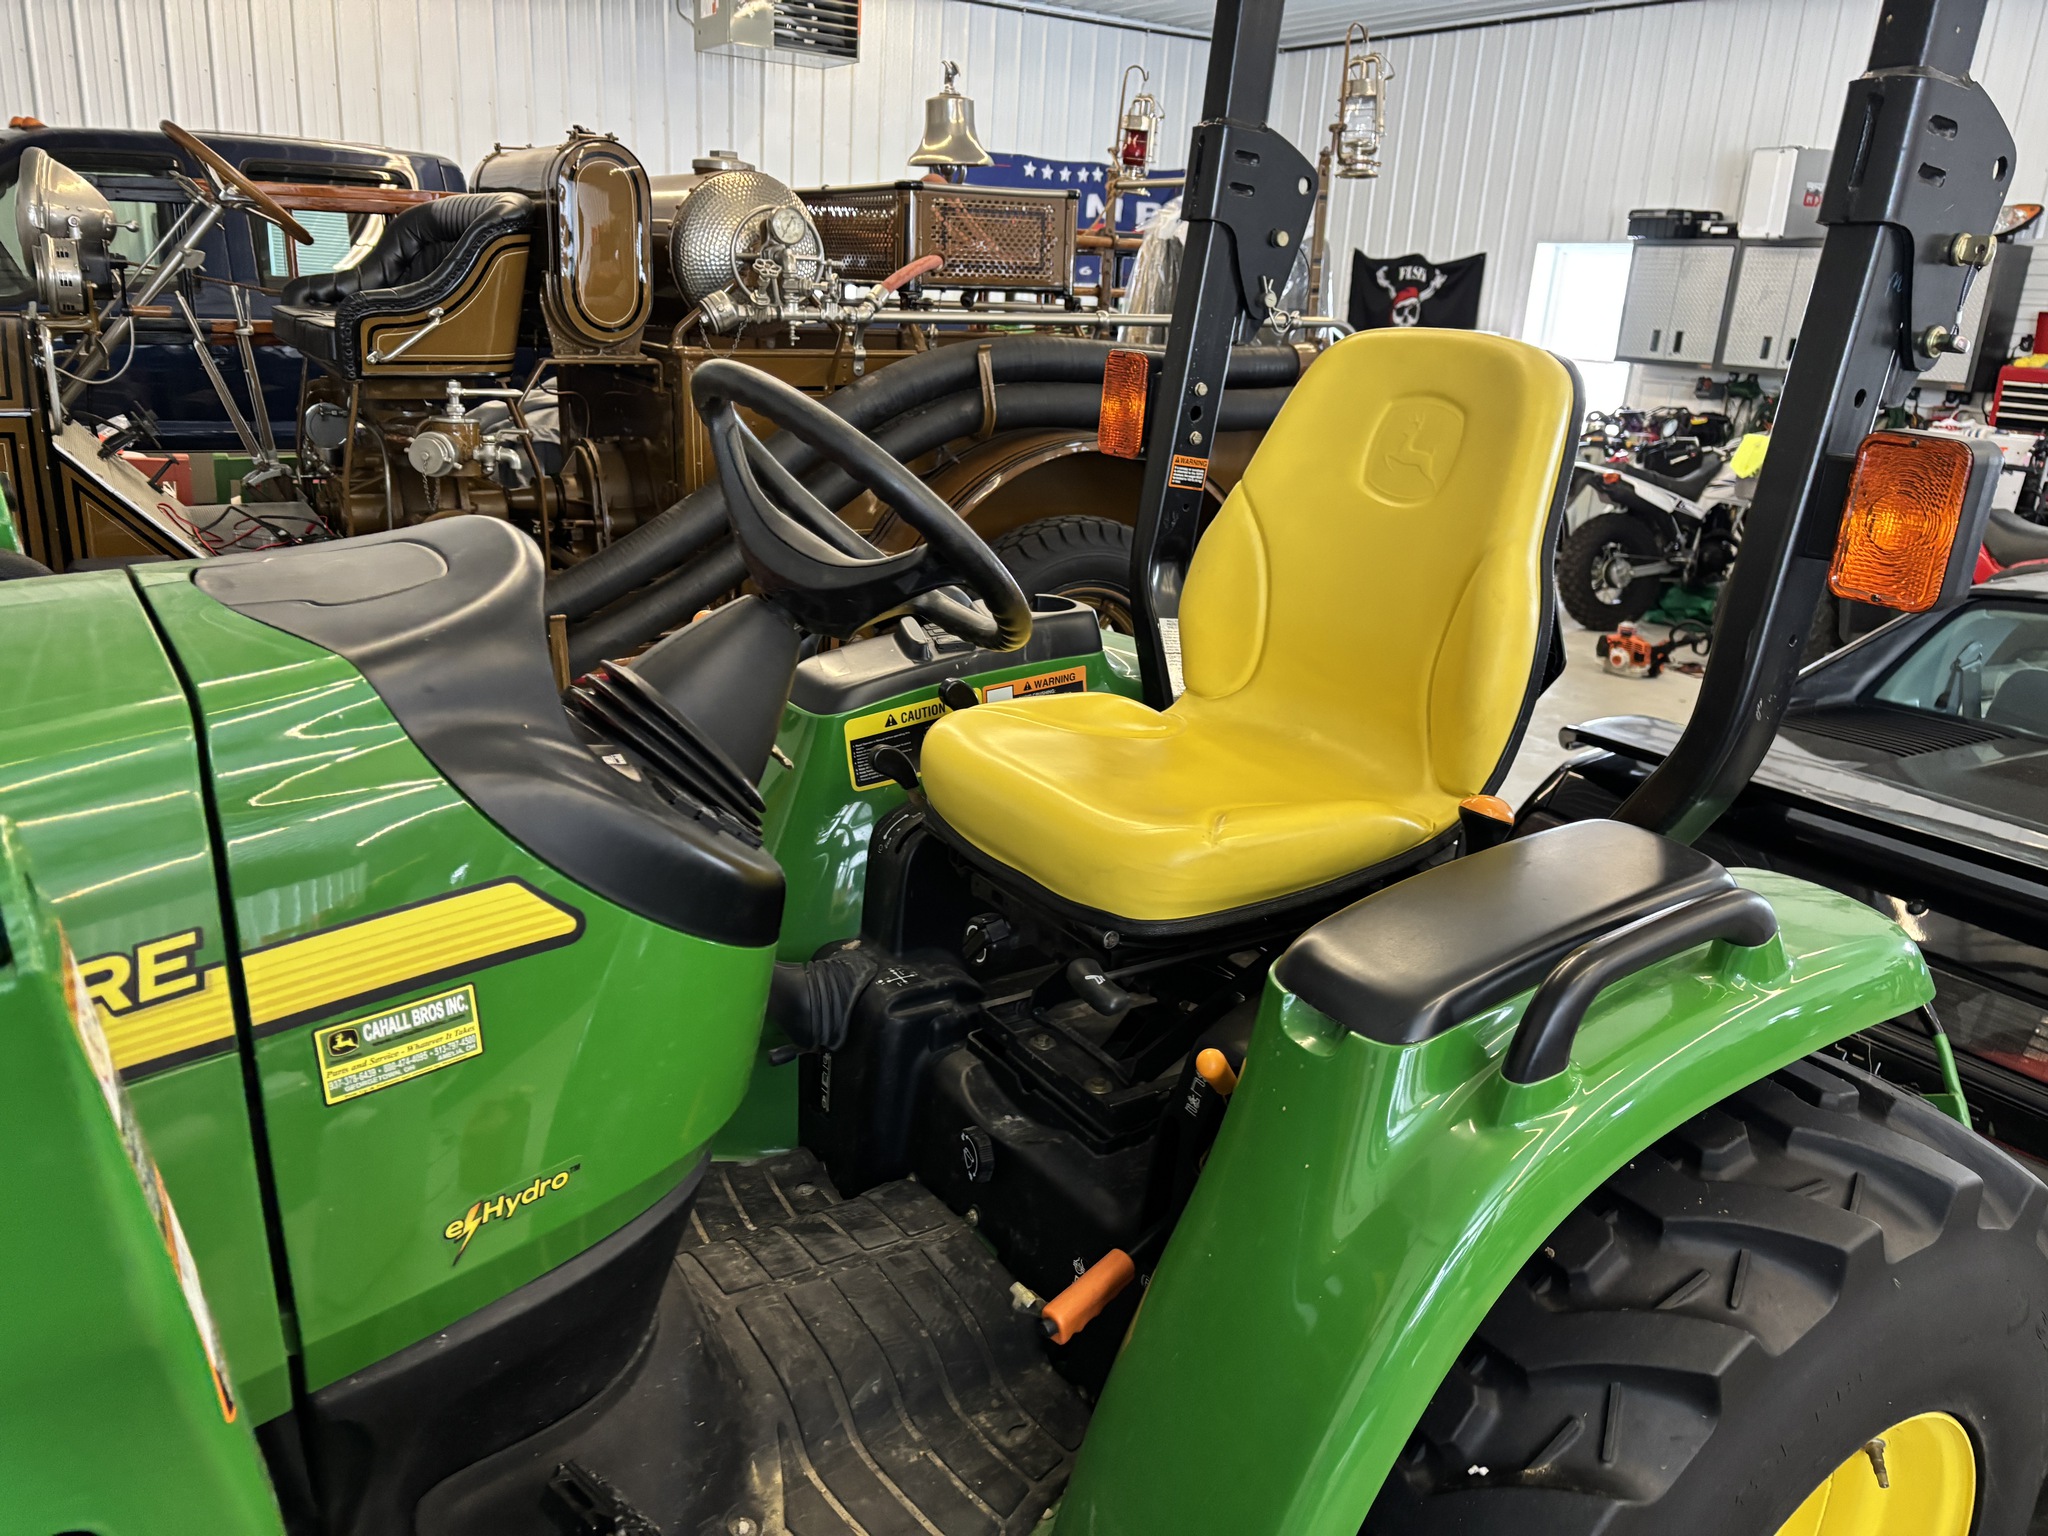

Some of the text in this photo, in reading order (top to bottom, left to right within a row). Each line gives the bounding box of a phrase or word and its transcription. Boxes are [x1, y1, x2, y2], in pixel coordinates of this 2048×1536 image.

[1180, 457, 1208, 467] WARNING
[1033, 672, 1076, 689] WARNING
[900, 703, 946, 724] CAUTION
[362, 1015, 412, 1042] CAHALL
[411, 1001, 446, 1027] BROS
[445, 994, 470, 1016] INC.
[326, 1067, 350, 1079] Parts
[351, 1057, 367, 1071] and
[368, 1050, 399, 1067] Service
[406, 1036, 444, 1052] Whatever
[444, 1030, 453, 1041] It
[454, 1024, 476, 1037] Takes
